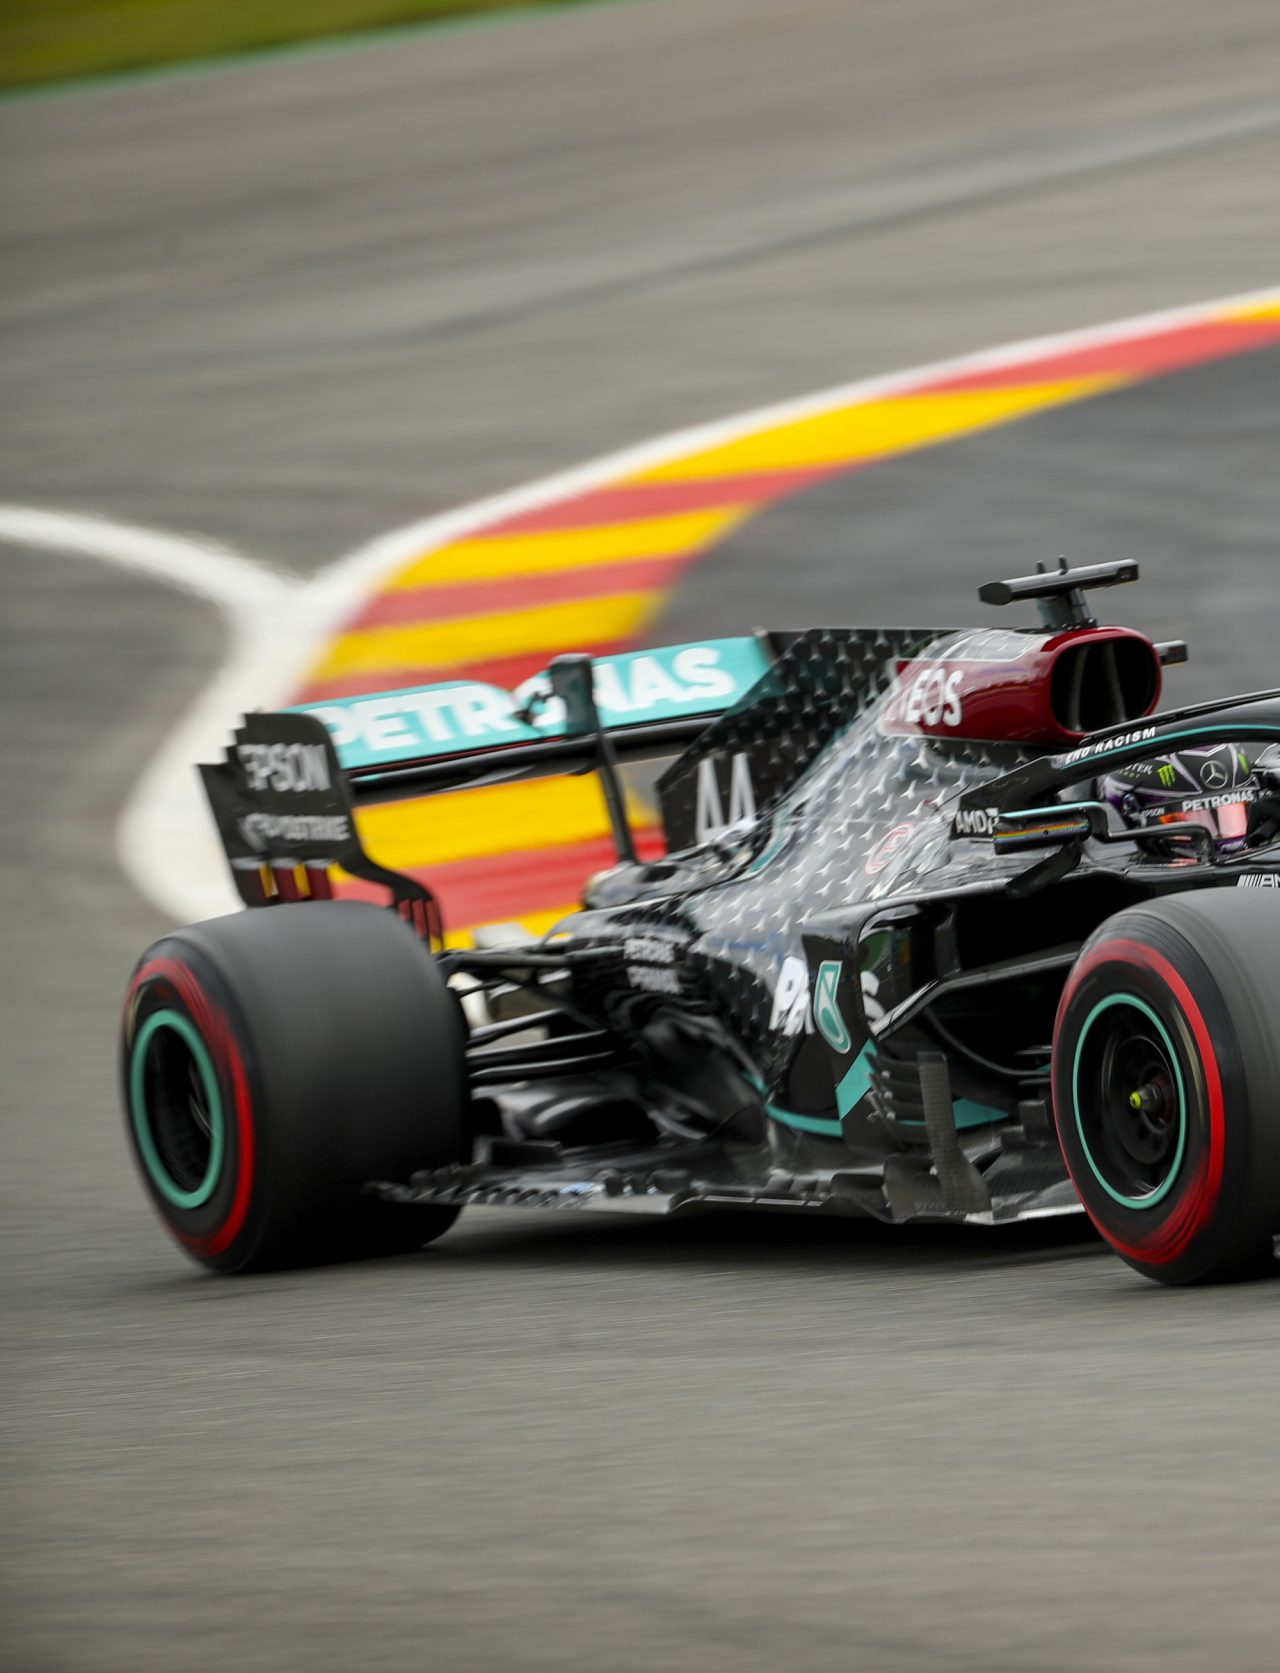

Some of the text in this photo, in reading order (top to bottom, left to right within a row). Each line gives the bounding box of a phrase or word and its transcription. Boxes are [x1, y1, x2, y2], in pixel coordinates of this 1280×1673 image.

[1064, 727, 1156, 765] END RACISM
[1182, 790, 1257, 812] PETRONAS
[955, 809, 988, 834] AMD
